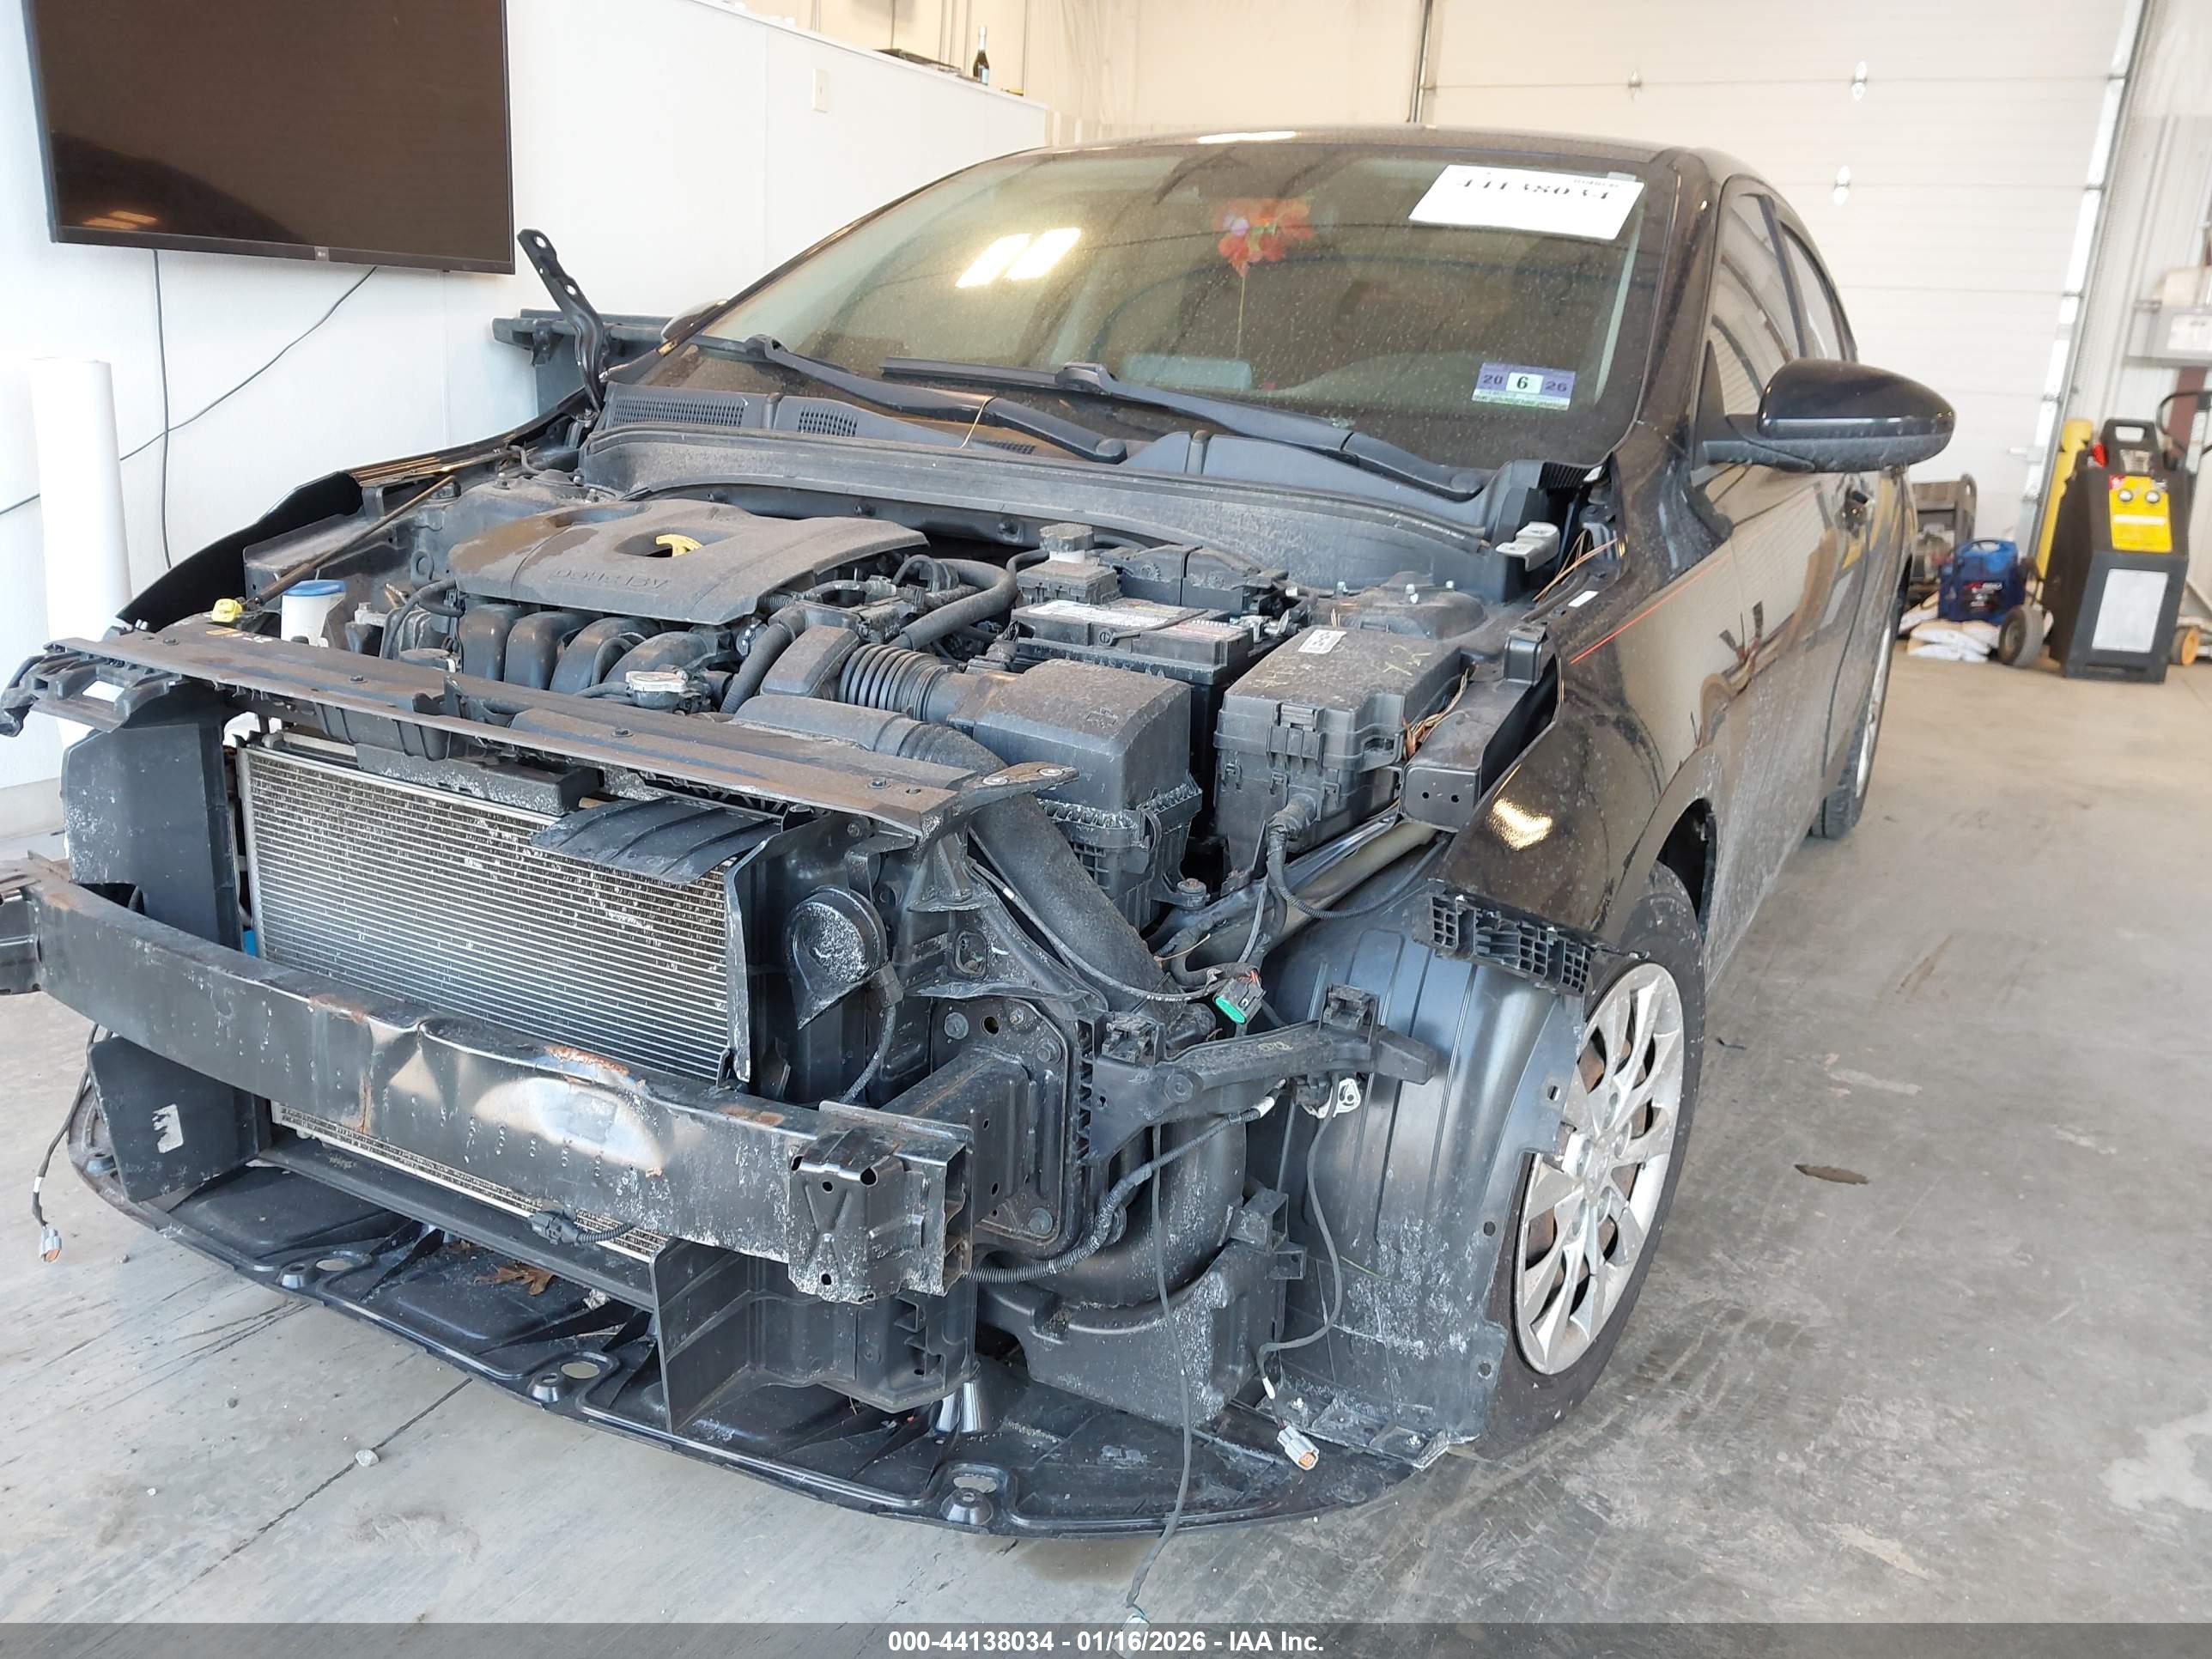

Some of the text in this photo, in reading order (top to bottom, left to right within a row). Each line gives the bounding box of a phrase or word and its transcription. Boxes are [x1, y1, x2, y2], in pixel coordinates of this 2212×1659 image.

[1482, 374, 1568, 392] 20 6 26
